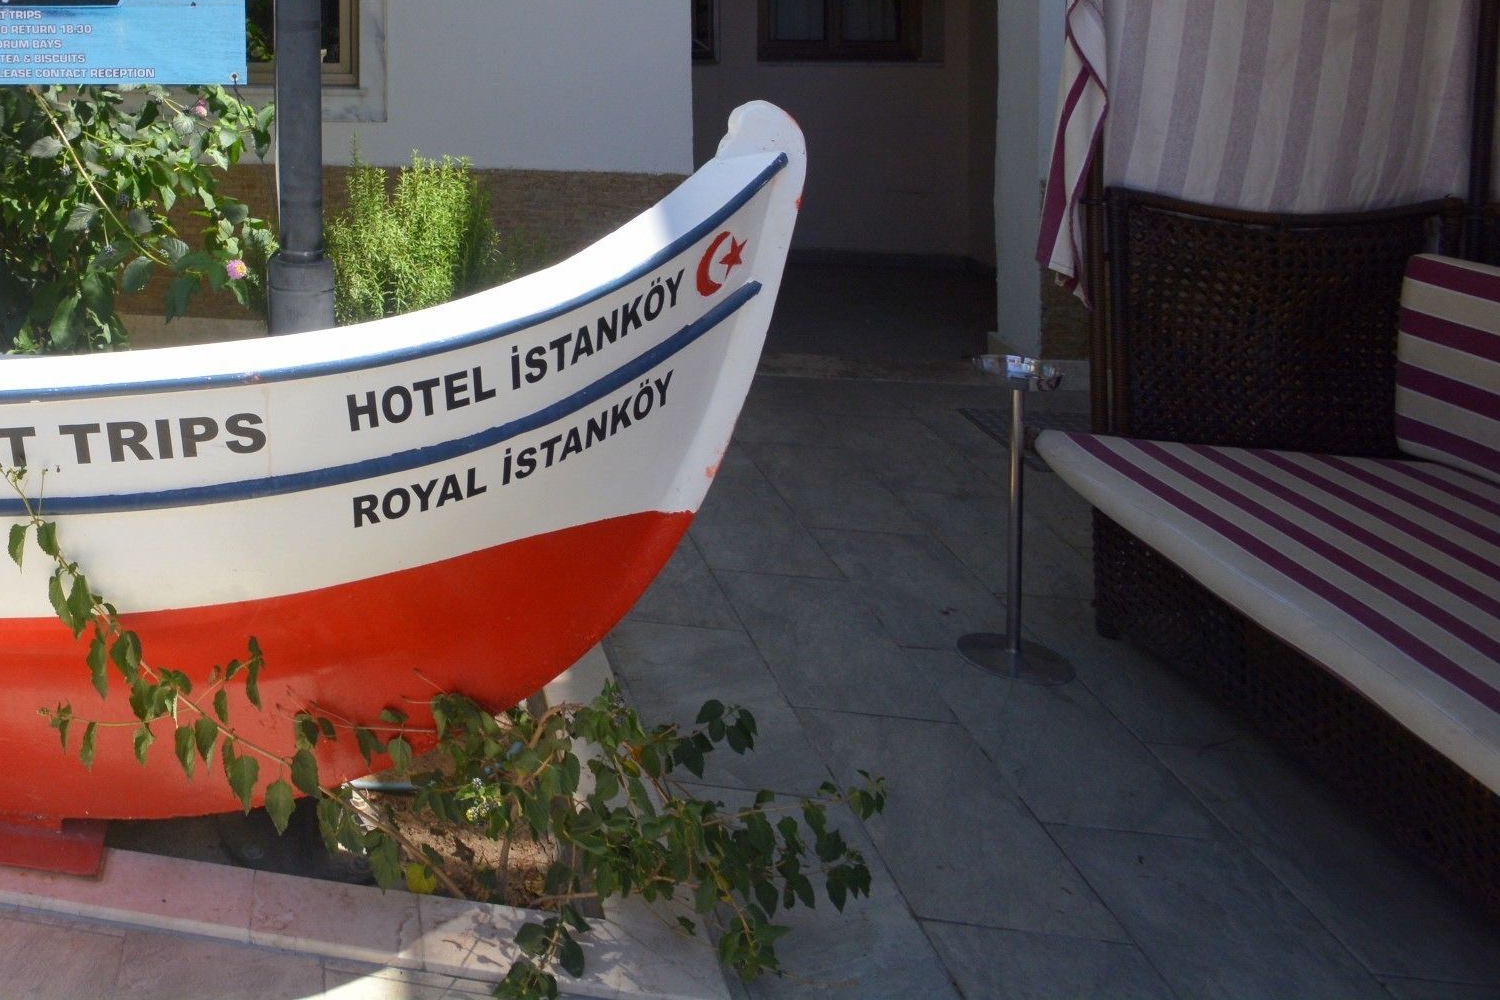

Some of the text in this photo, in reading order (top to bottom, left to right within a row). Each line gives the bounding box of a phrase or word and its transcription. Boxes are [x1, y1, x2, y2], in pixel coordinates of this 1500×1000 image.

[9, 10, 42, 20] TRIPS
[11, 24, 56, 34] RETURN
[60, 24, 92, 34] 18.30
[32, 39, 62, 49] BAYS
[0, 54, 20, 63] TEA
[23, 54, 31, 63] &
[34, 53, 86, 63] BISCUITS
[35, 68, 87, 78] CONTACT
[90, 68, 155, 78] RECEPTION
[346, 269, 685, 431] HOTEL İSTANKÖY
[58, 412, 267, 464] TRIPS
[353, 370, 674, 528] ROYAL İSTANKÖY
